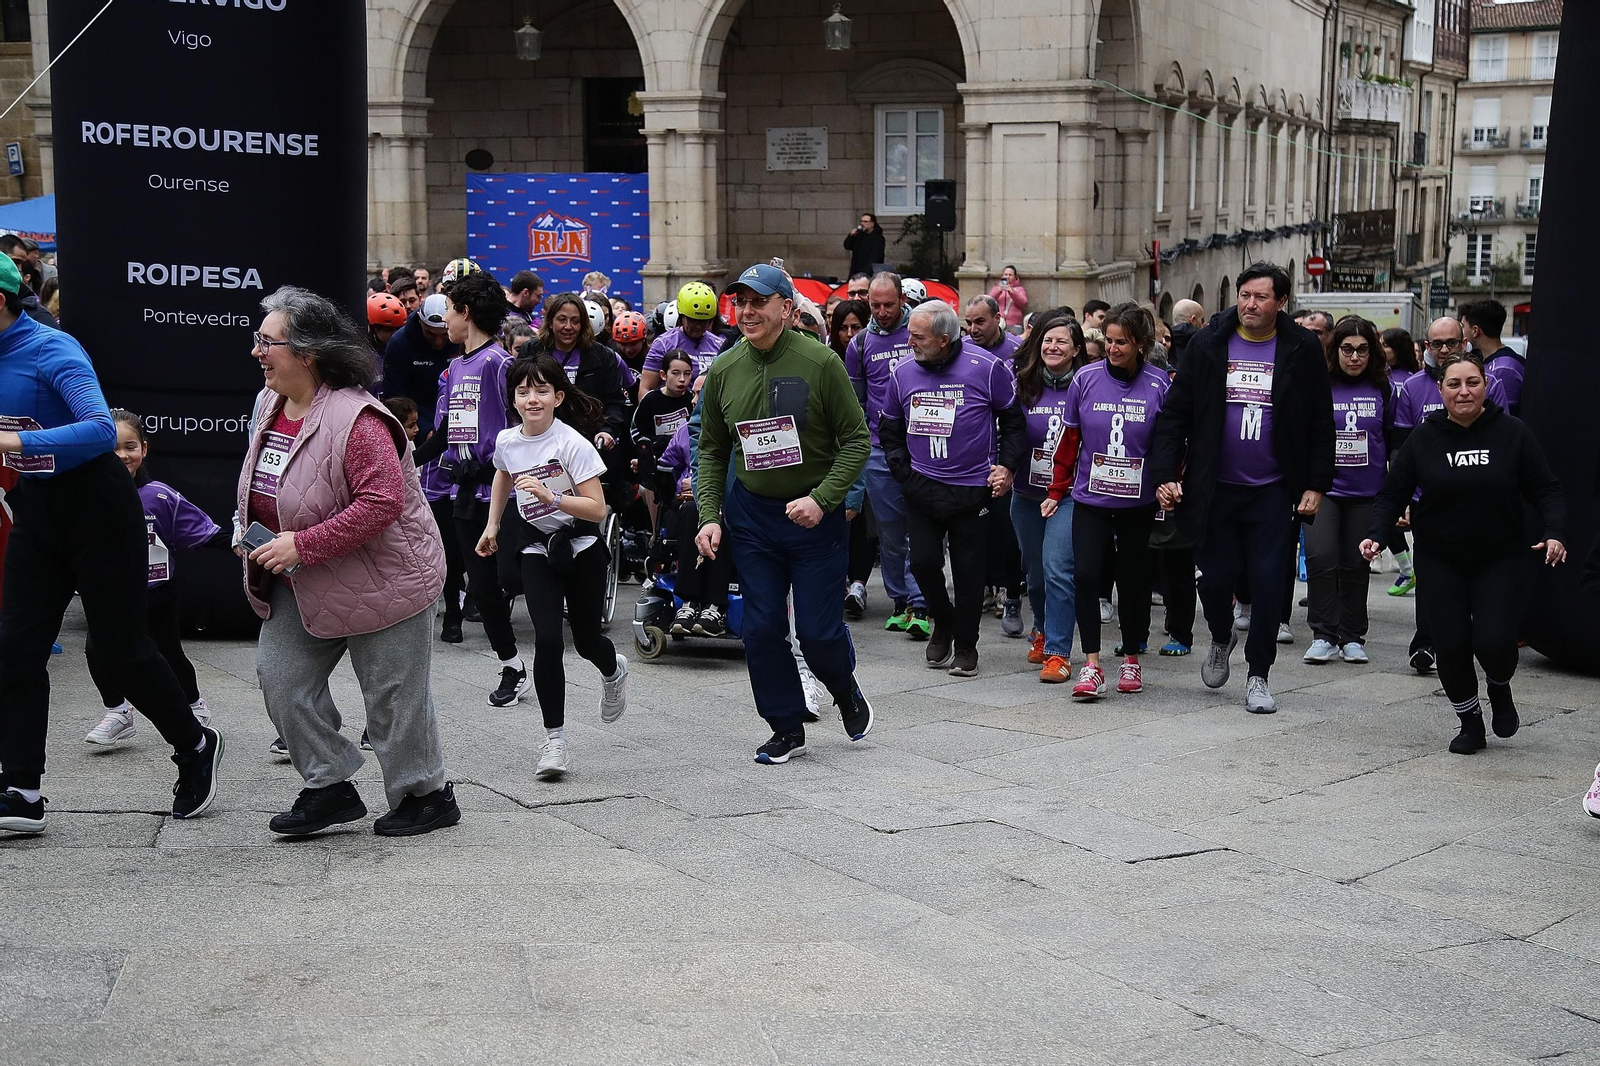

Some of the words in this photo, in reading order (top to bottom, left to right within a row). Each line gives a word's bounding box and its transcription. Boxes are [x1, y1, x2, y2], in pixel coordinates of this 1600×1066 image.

[167, 29, 212, 50] Vigo
[81, 121, 319, 156] ROFEROURENSE
[148, 174, 230, 193] Ourense
[532, 229, 588, 256] RUN
[127, 262, 264, 290] ROIPESA
[143, 308, 250, 326] Pontevedra
[1241, 373, 1259, 383] 814
[924, 408, 939, 416] 744
[1093, 402, 1117, 412] CARREIRA
[1117, 404, 1125, 413] DA
[1126, 405, 1145, 414] MULLER
[1124, 413, 1146, 422] OURENSE
[1240, 407, 1263, 440] M
[757, 434, 777, 447] 854
[1338, 441, 1353, 449] 739
[262, 451, 281, 466] 853
[1446, 449, 1489, 467] VANS
[1108, 468, 1125, 477] 815
